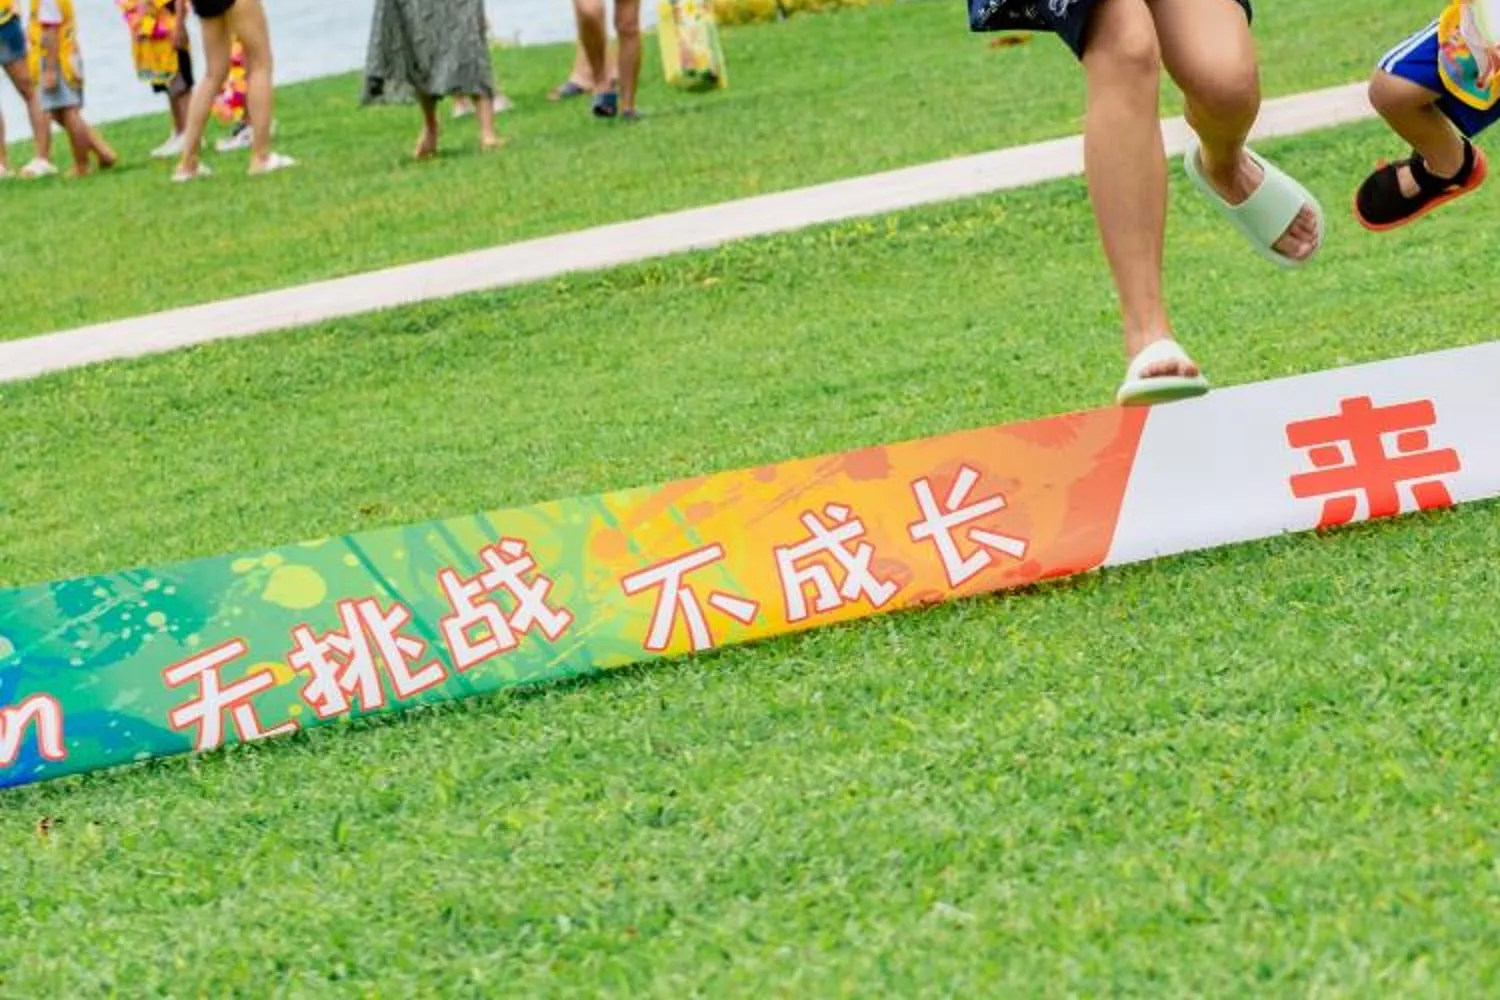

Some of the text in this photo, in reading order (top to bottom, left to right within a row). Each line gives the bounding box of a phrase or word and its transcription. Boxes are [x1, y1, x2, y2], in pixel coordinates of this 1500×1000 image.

[163, 463, 1030, 752] 无挑战 不成长
